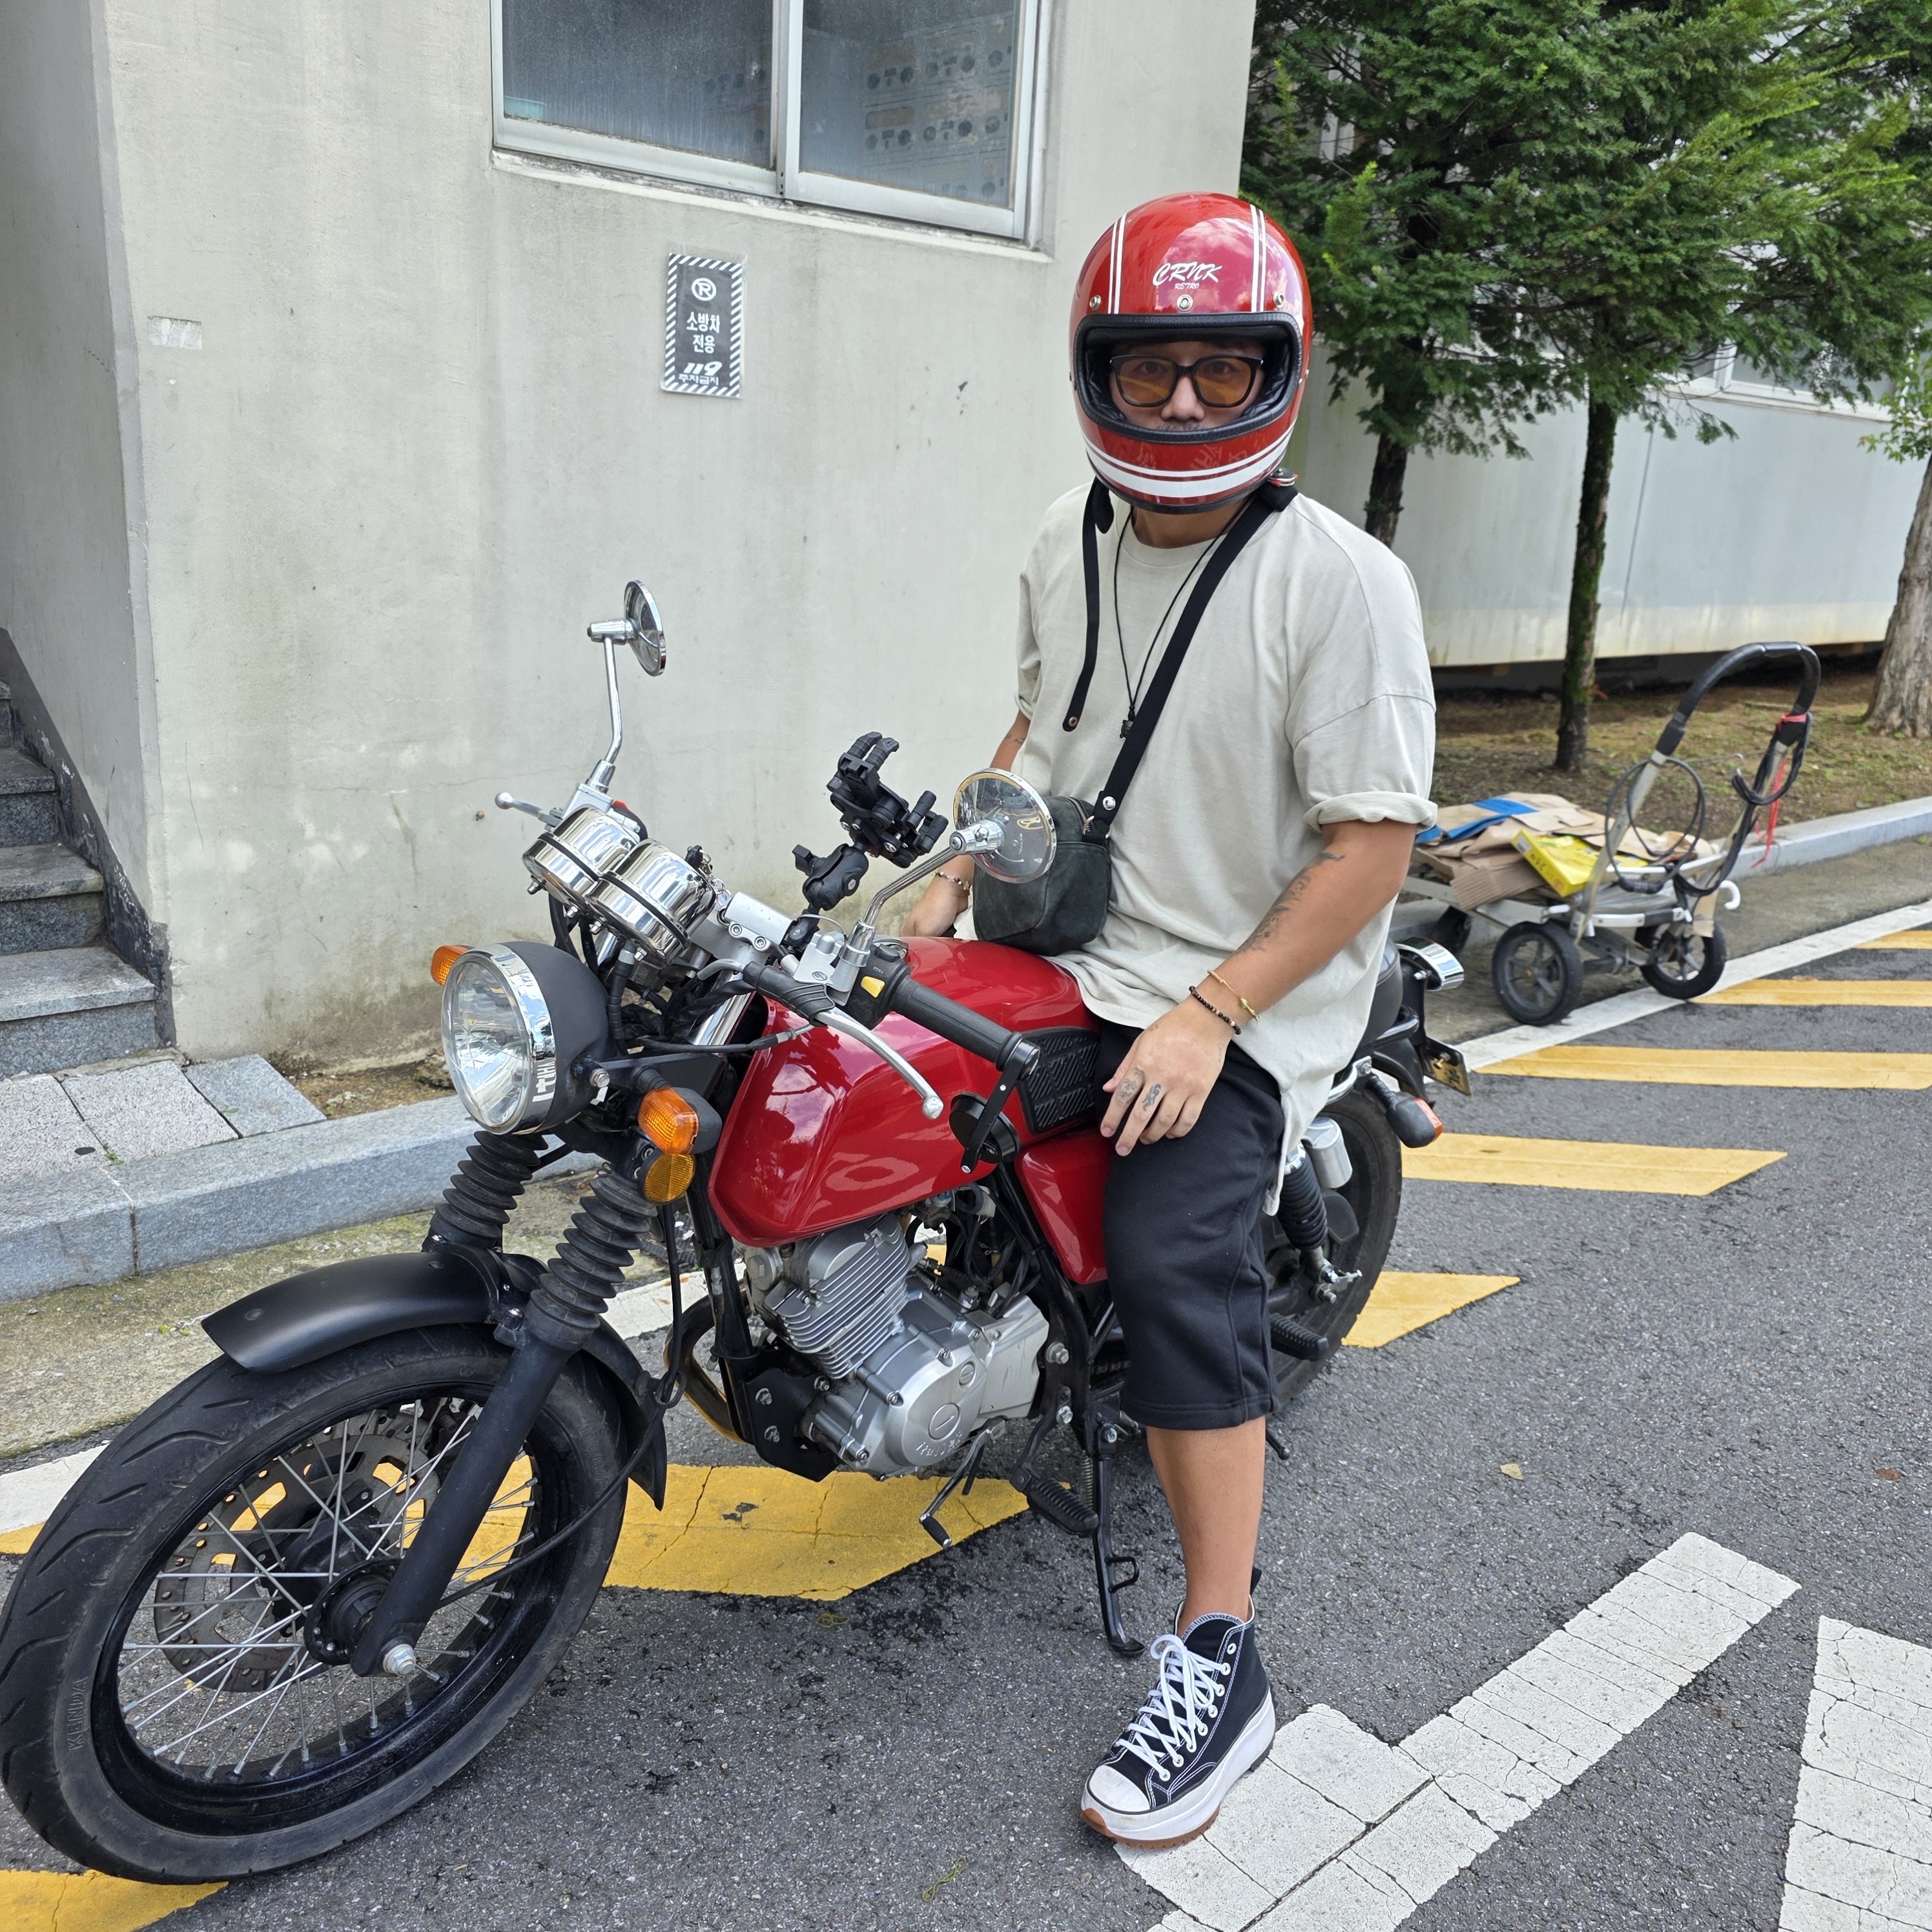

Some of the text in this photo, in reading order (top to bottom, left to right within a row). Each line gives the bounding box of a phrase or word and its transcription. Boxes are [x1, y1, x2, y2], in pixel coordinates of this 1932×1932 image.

[1153, 262, 1222, 286] CRNK
[686, 311, 721, 334] 소방차
[693, 334, 715, 354] 전용
[679, 373, 719, 385] 주차금지
[683, 361, 723, 376] 119
[67, 1676, 88, 1751] KENDA
